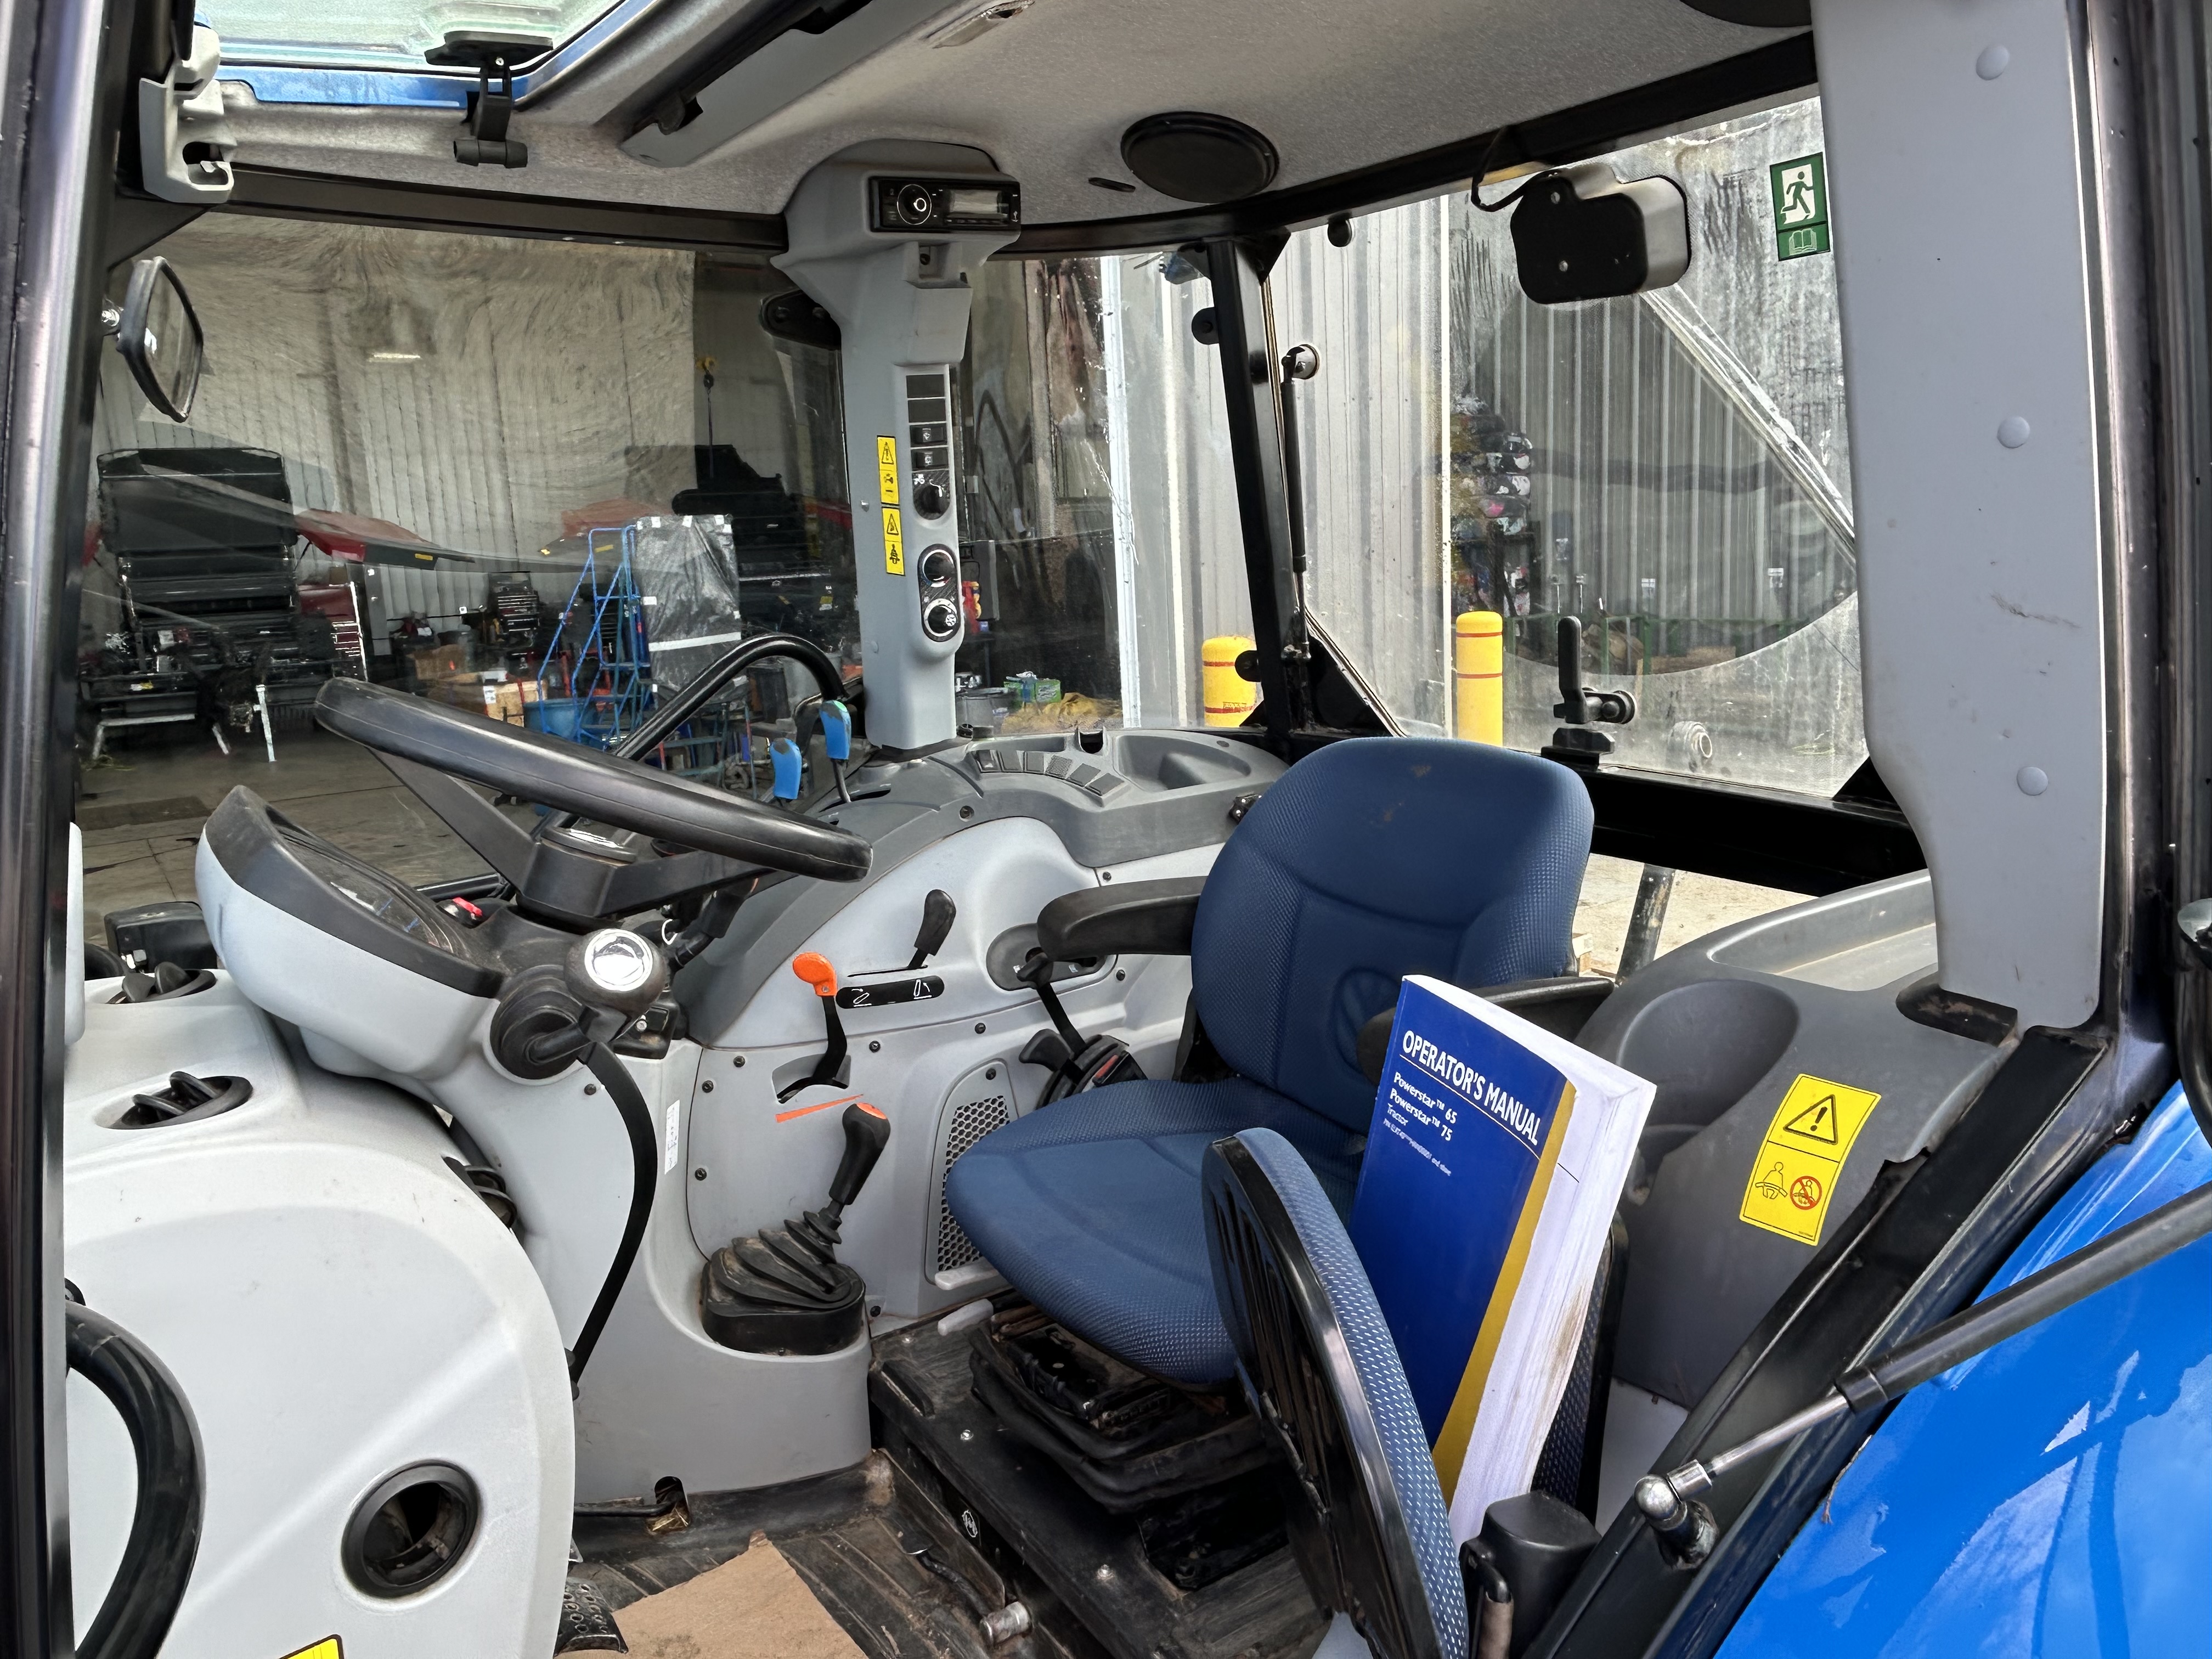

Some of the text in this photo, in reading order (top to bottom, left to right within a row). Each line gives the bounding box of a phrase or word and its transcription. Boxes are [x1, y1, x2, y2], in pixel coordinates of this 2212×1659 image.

[1402, 1030, 1486, 1100] OPERATOR'S
[1484, 1082, 1541, 1146] MANUAL
[1445, 1108, 1458, 1124] 65
[1441, 1125, 1453, 1141] 75
